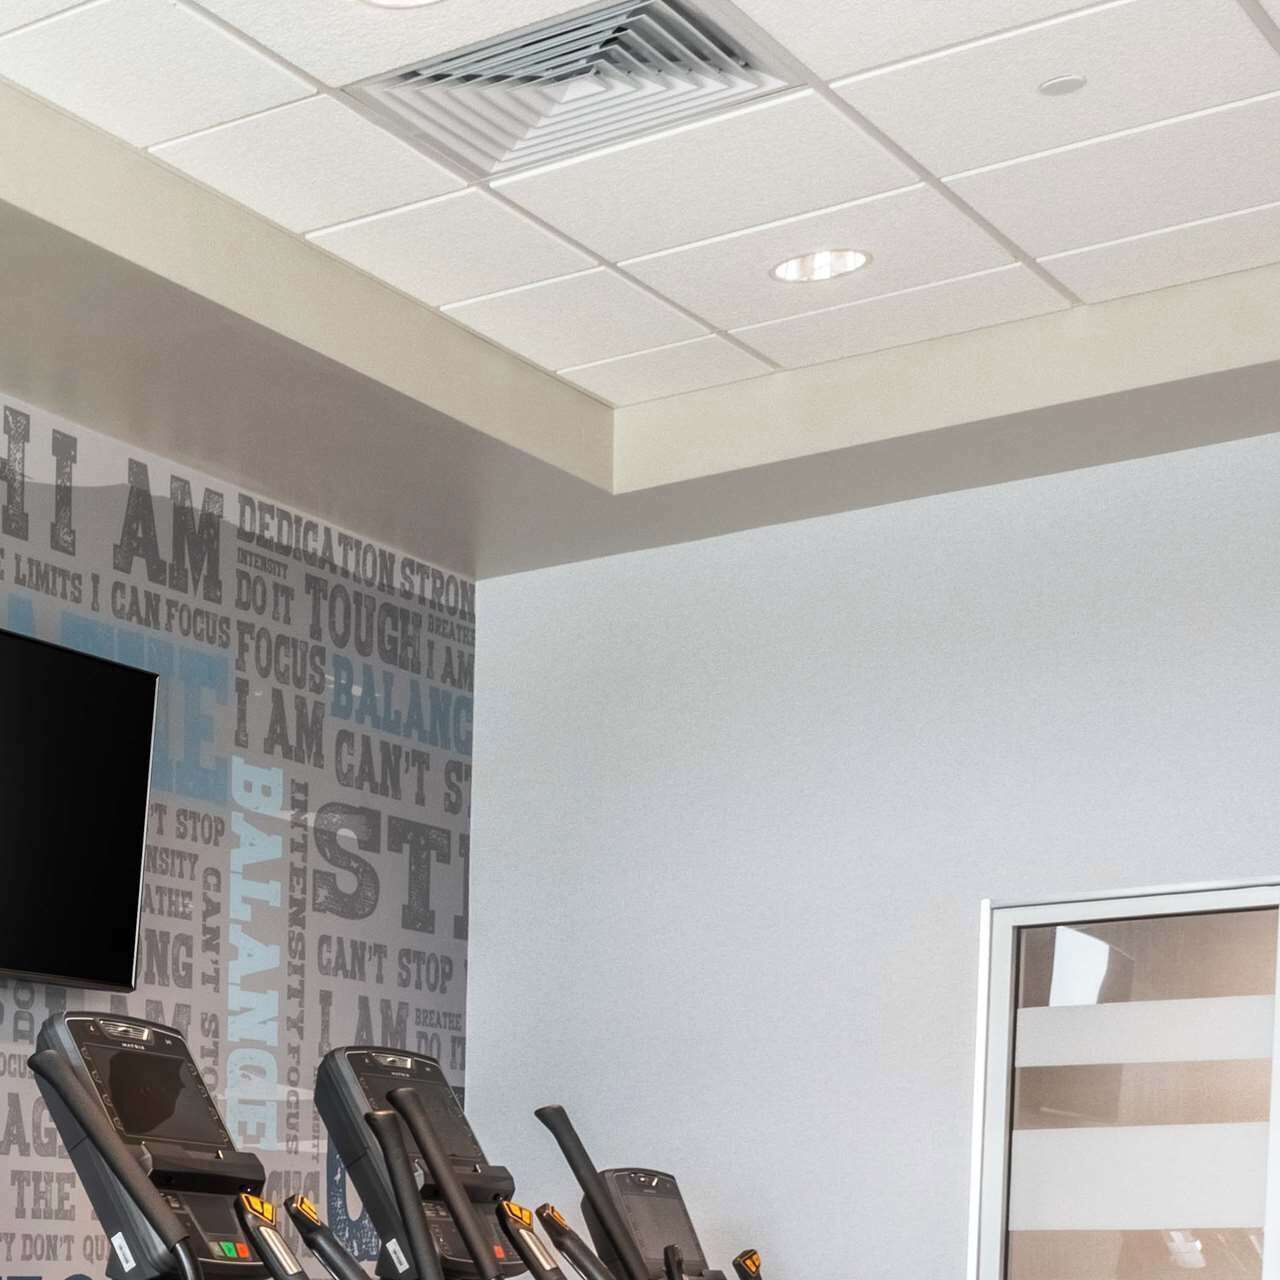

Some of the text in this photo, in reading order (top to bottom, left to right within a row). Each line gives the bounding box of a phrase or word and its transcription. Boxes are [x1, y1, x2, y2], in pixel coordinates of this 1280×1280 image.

[51, 428, 77, 557] I
[113, 456, 224, 605] AM
[237, 492, 396, 596] DEDICATION
[237, 547, 289, 580] INTENSITY
[13, 552, 82, 606] LIMITS
[91, 573, 101, 612] I
[111, 580, 161, 631] CAN
[164, 606, 231, 650] FOCUS
[235, 568, 422, 675] DO IT TOUGH
[236, 619, 326, 695] FOCUS
[234, 677, 430, 806] I AM CAN'T
[175, 808, 225, 847] STOP
[200, 866, 222, 993] CAN'T
[225, 754, 285, 1154] BALANCE
[285, 778, 309, 1156] INTENSITY FOCUS
[317, 934, 453, 993] CAN'T STOP
[355, 995, 410, 1052] AM
[415, 1008, 462, 1032] BREATHE
[10, 1170, 76, 1221] THE
[21, 1232, 76, 1263] DON'T
